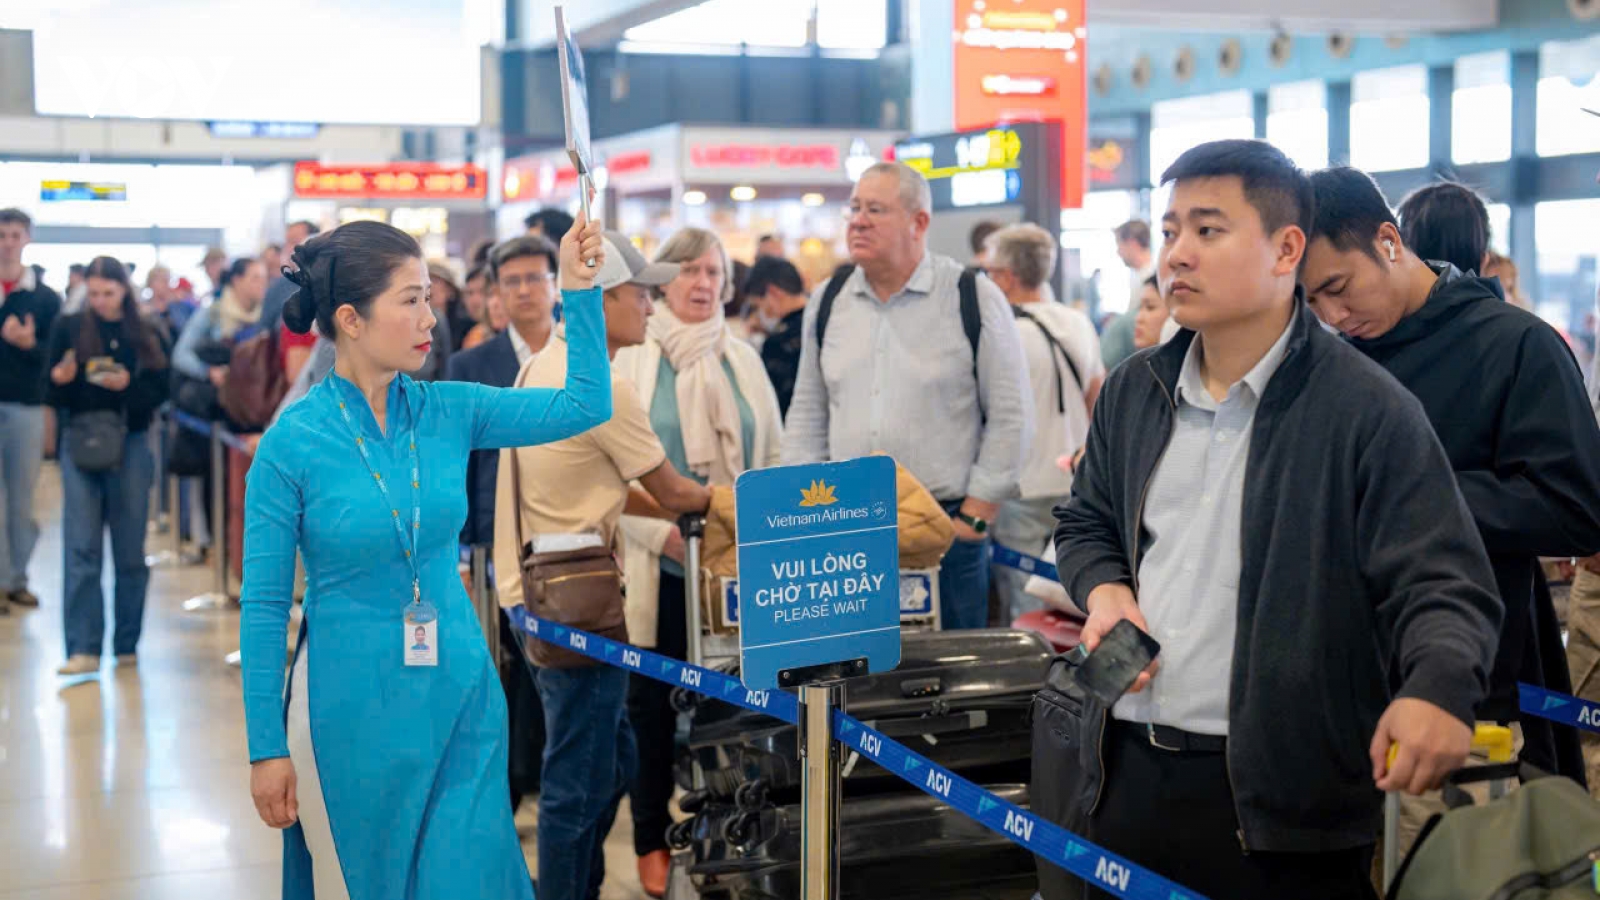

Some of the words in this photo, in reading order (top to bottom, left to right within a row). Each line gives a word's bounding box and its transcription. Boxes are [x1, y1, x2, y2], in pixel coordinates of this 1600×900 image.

[767, 513, 820, 528] Vietnam
[821, 507, 868, 521] Airlines
[771, 558, 805, 580] VUI
[811, 552, 867, 576] LÒNG
[755, 584, 801, 607] CHỜ
[807, 580, 838, 602] TẠI
[843, 573, 885, 595] ĐÂY
[774, 604, 829, 623] PLEASE
[833, 599, 868, 615] WAIT
[570, 632, 587, 650] ACV
[622, 648, 641, 668] ACV
[680, 667, 702, 687] ACV
[745, 689, 770, 709] ACV
[859, 730, 882, 757] ACV
[926, 768, 952, 797] ACV
[1003, 810, 1035, 842] ACV
[1095, 856, 1131, 891] ACV
